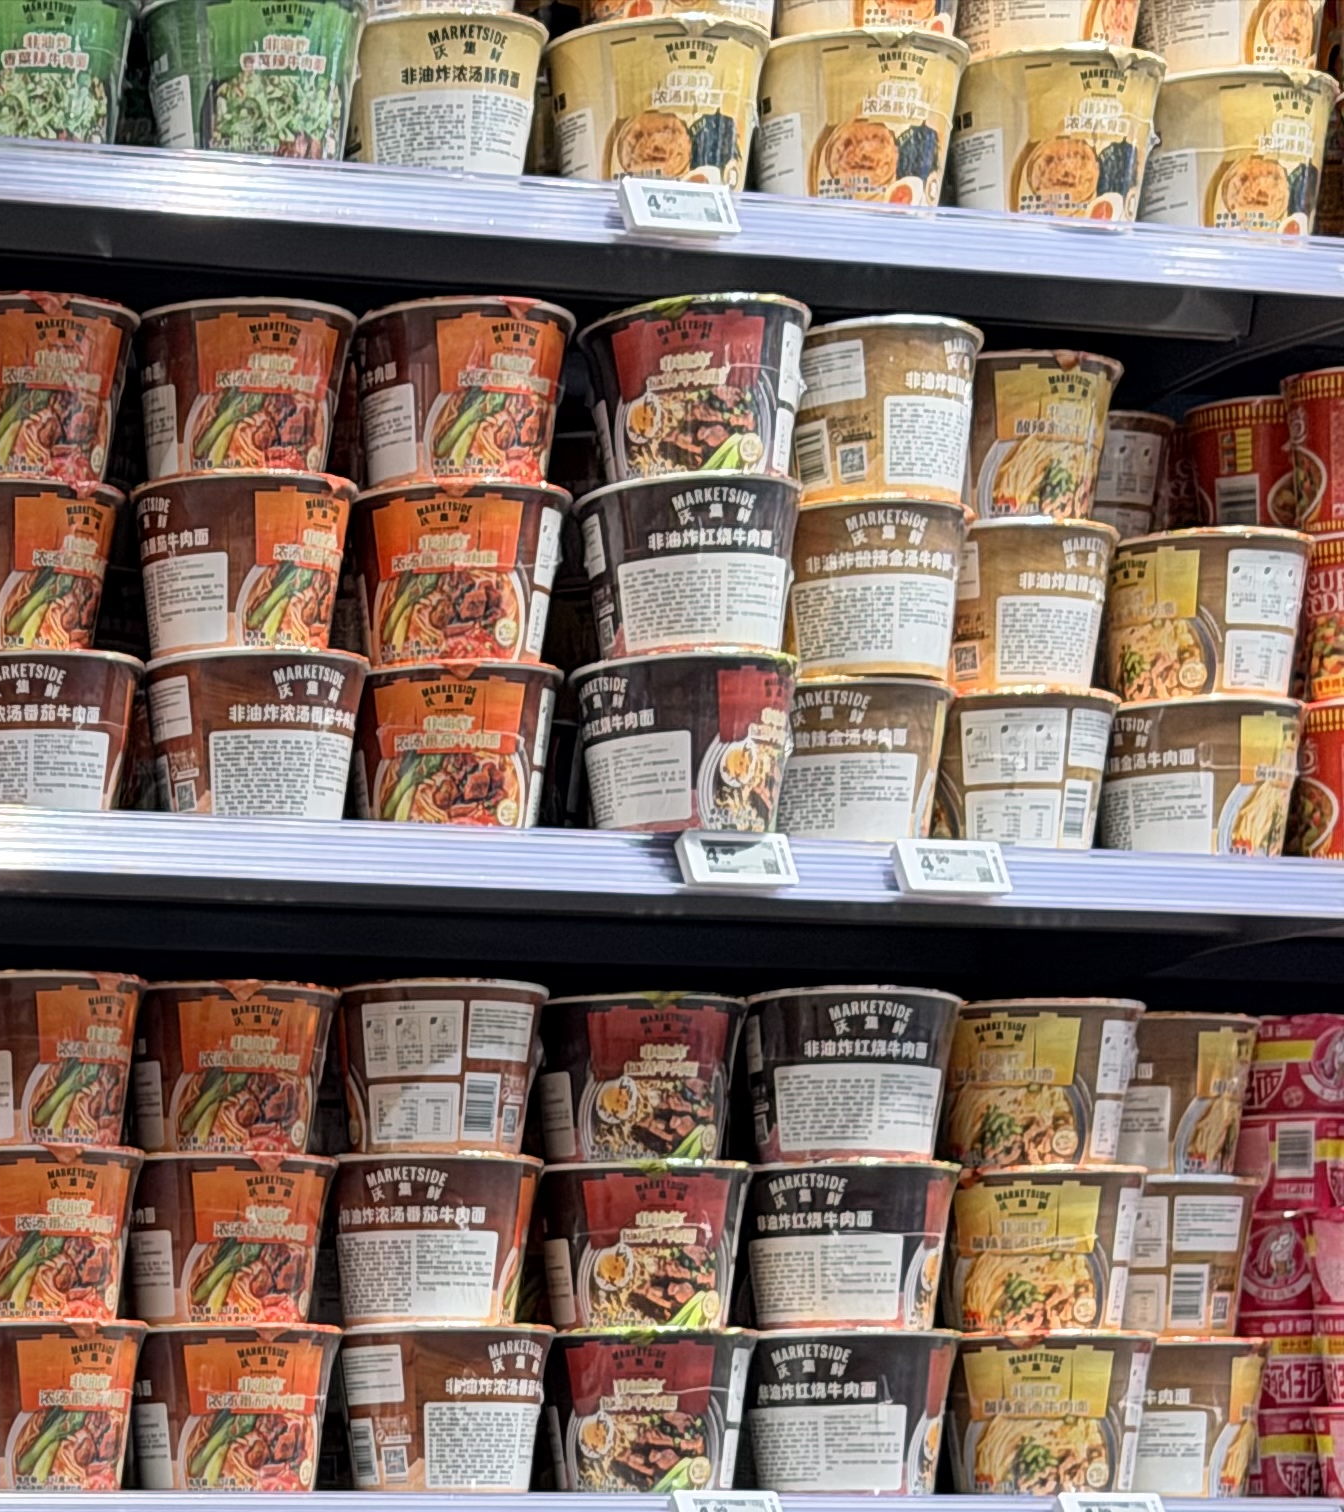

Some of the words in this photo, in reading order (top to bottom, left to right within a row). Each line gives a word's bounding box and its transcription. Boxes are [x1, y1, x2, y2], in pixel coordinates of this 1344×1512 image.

[428, 24, 508, 49] MARKETSIDE
[672, 487, 757, 510] MARKETSIDE
[846, 510, 929, 532] MARKETSIDE
[648, 530, 772, 550] 非油炸红烧牛肉面
[273, 666, 346, 687] MARKETSIDE
[828, 1000, 913, 1021] MARKETSIDE
[804, 1040, 928, 1059] 非油炸红烧牛肉面
[366, 1166, 448, 1188] MARKETSIDE
[768, 1173, 848, 1193] MARKETSIDE
[771, 1343, 853, 1364] MARKETSIDE
